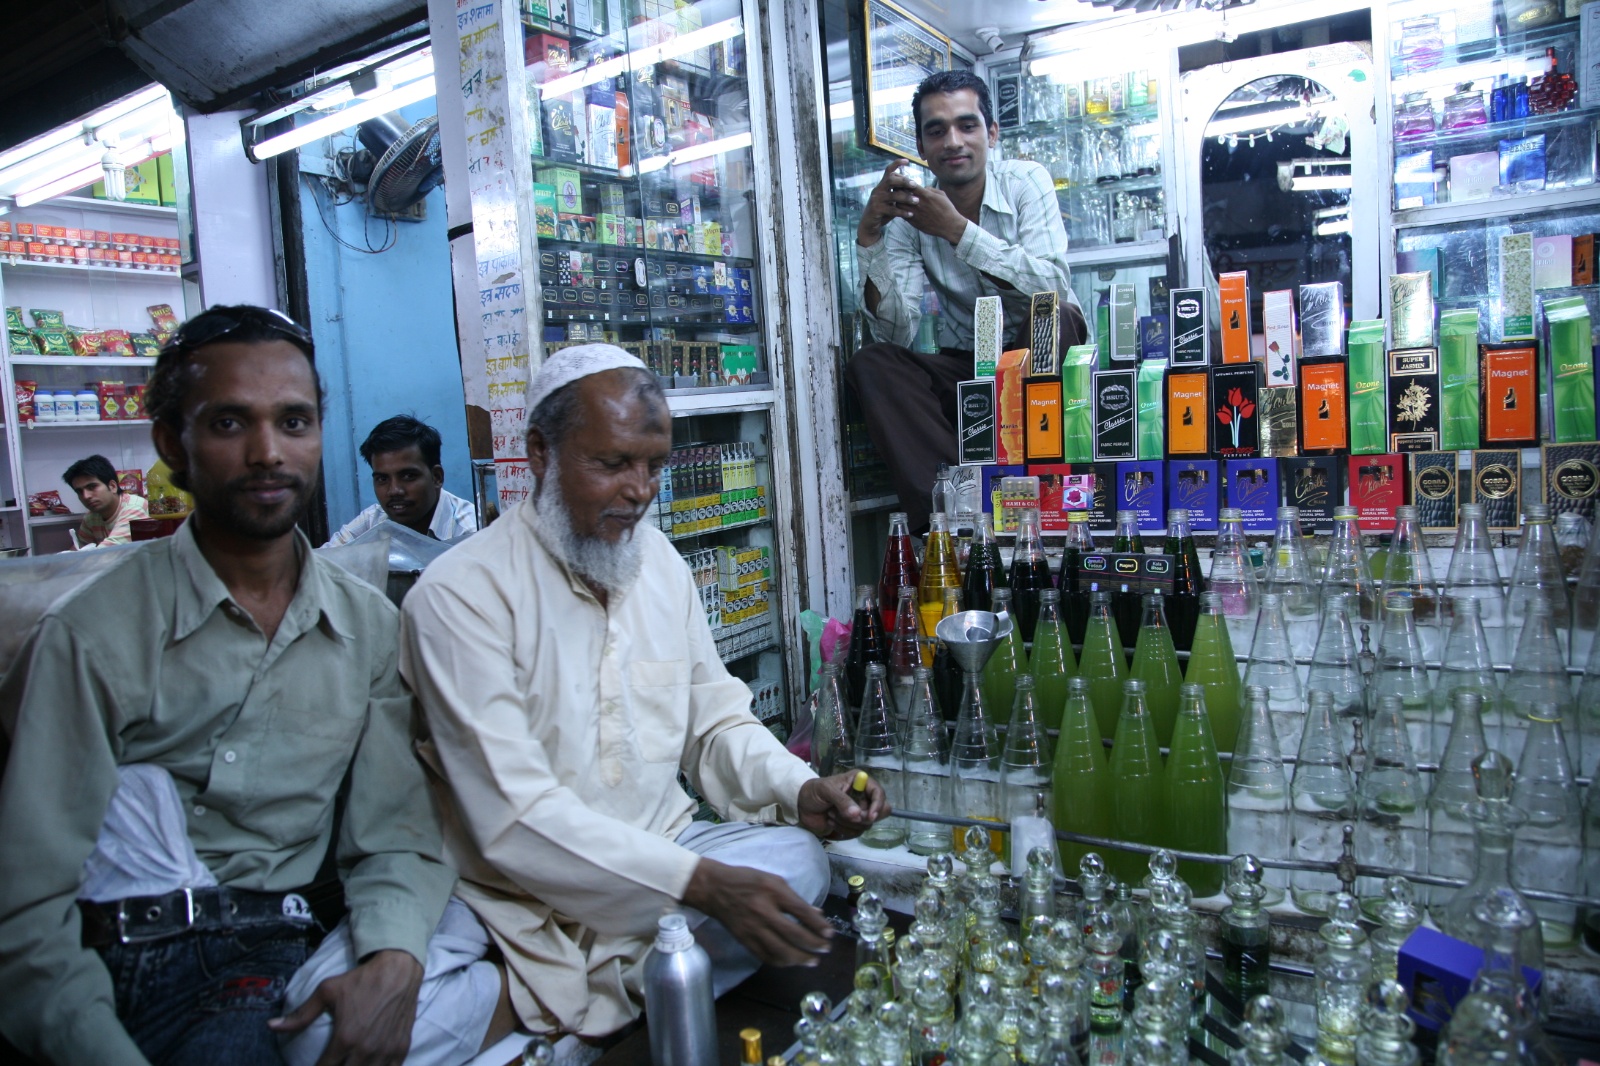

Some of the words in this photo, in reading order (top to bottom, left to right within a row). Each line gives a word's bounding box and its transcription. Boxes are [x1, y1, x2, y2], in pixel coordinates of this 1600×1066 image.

[1560, 362, 1588, 372] Ozone
[1491, 369, 1528, 378] Magnet
[1307, 382, 1340, 392] Magnet
[1355, 380, 1380, 389] Ozone
[1173, 391, 1202, 399] Magnet
[1068, 398, 1088, 406] Ozone
[1103, 416, 1126, 430] Classic
[967, 423, 987, 437] Classic
